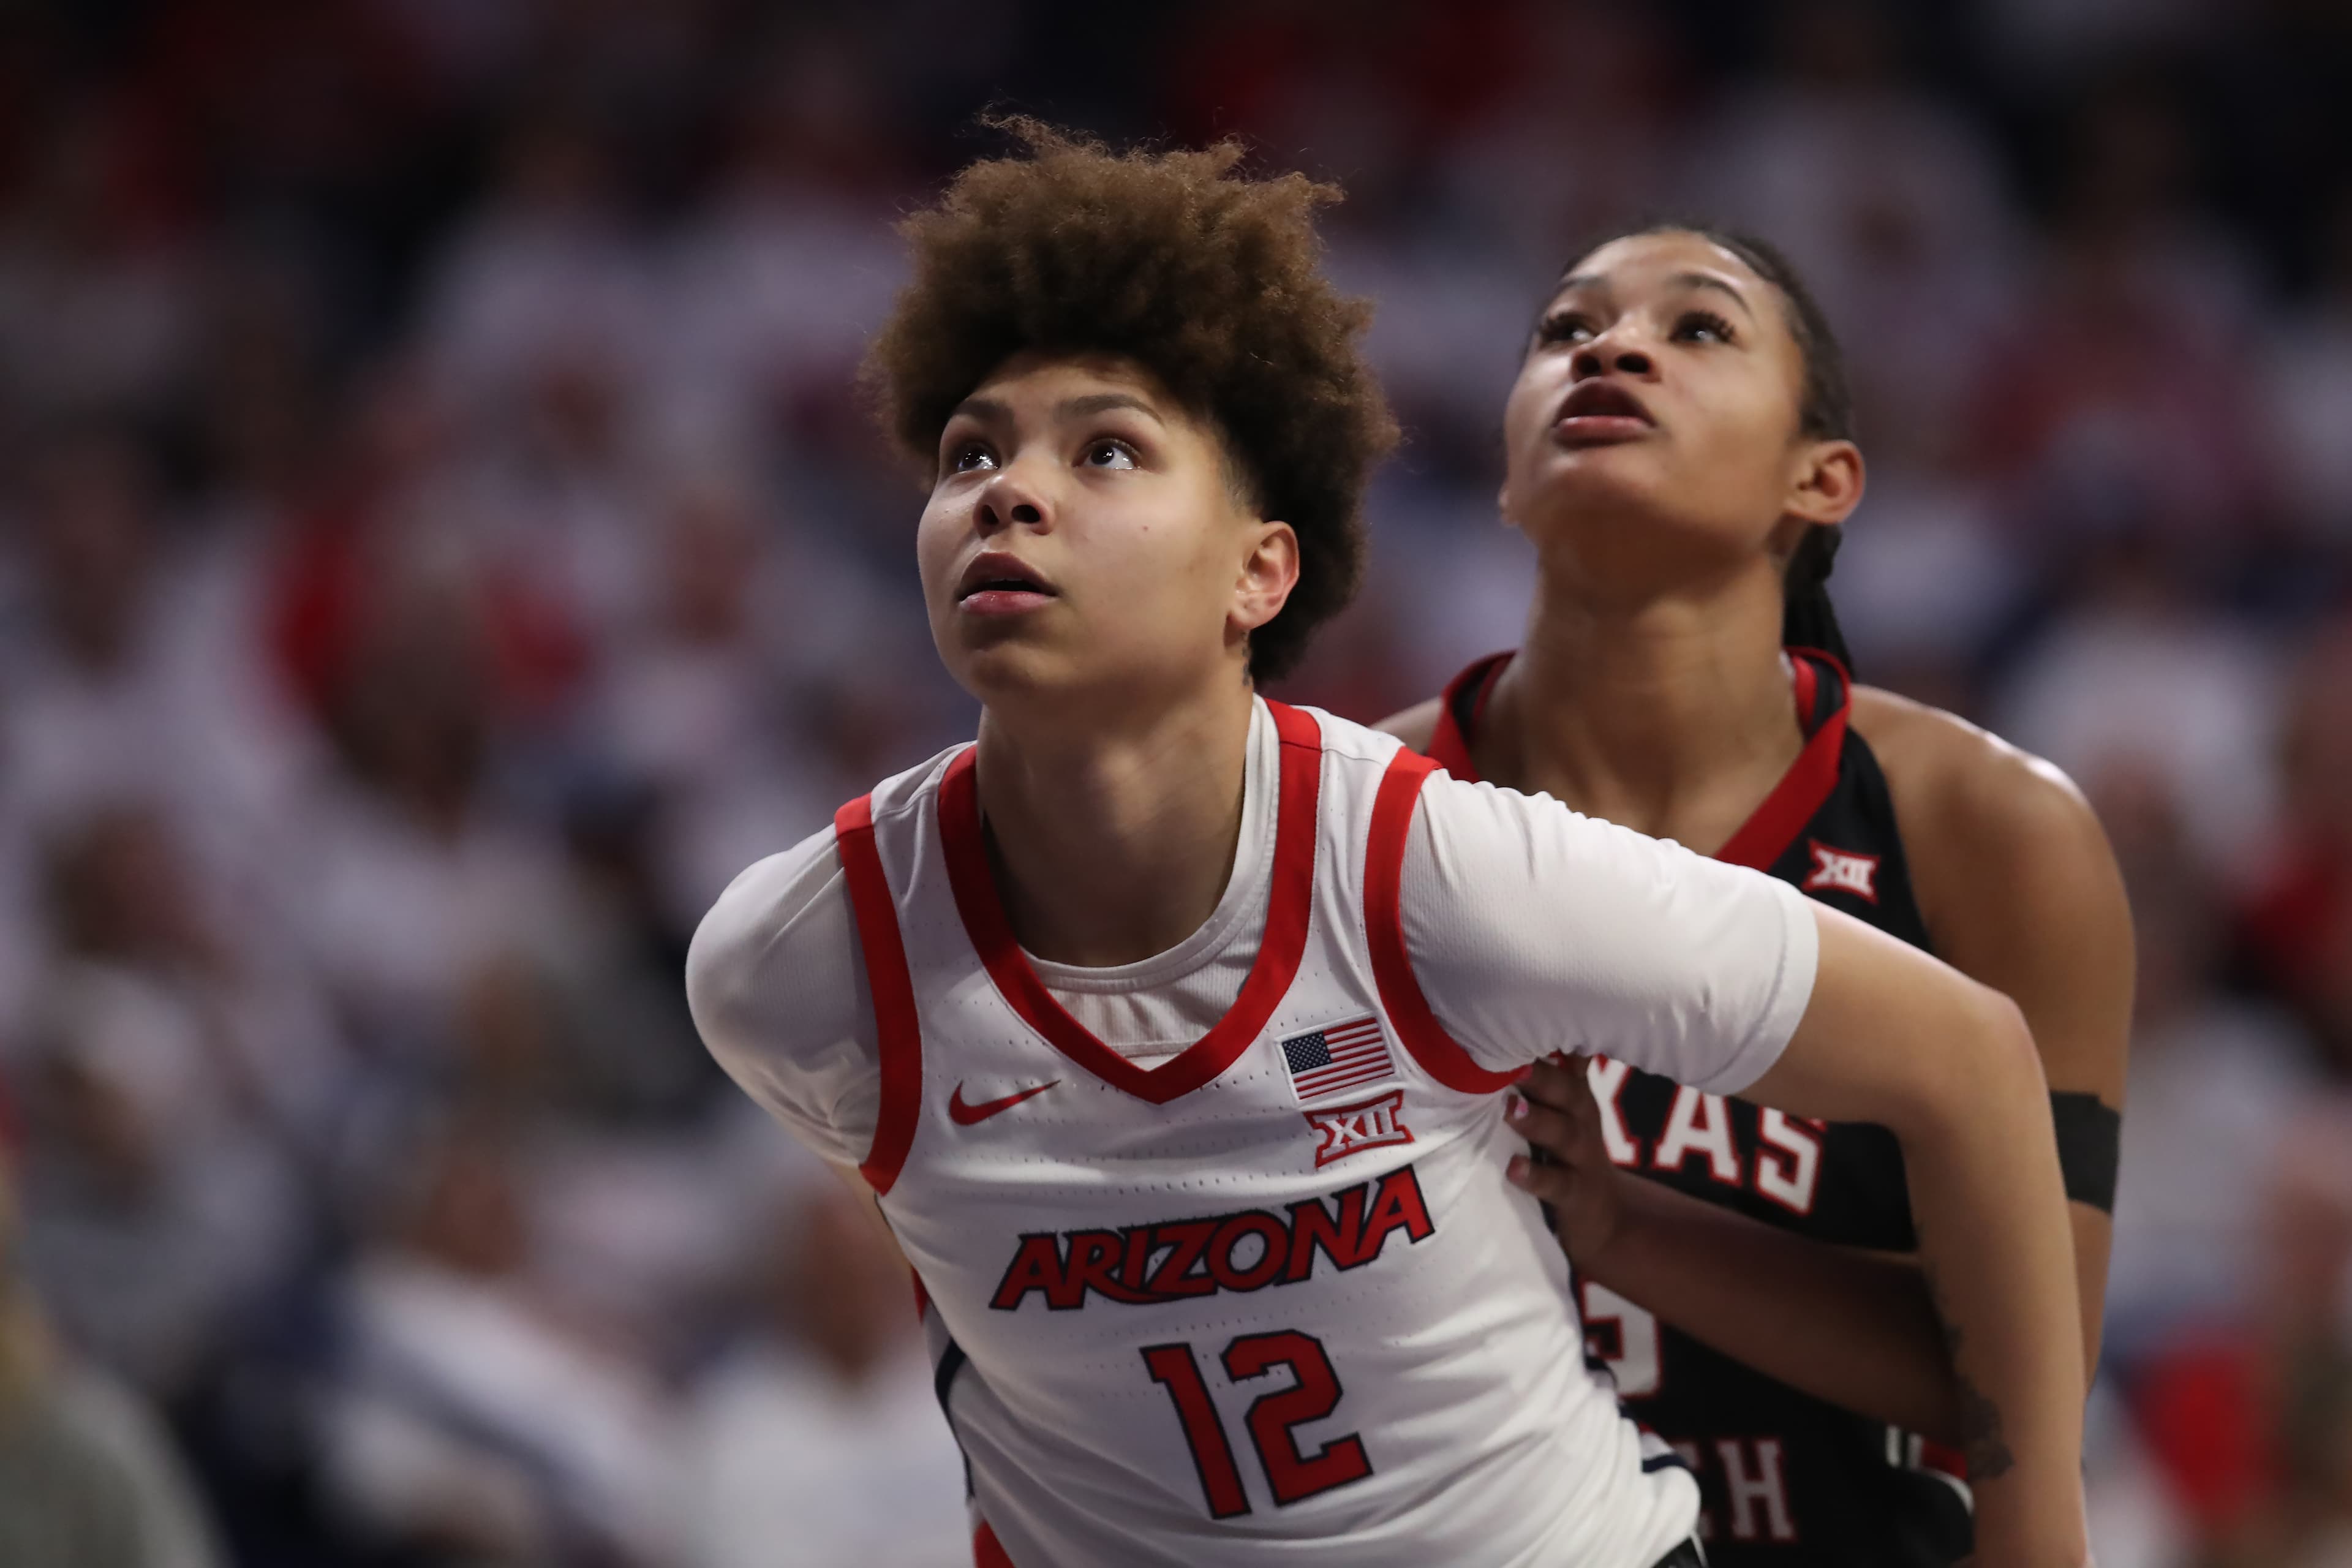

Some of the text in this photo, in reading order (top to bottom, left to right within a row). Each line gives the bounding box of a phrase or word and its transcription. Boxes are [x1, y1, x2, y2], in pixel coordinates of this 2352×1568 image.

[1311, 1093, 1409, 1156] XII
[1585, 1052, 1828, 1218] XAS
[989, 1164, 1435, 1311] ARIZONA
[1139, 1329, 1373, 1520] 12
